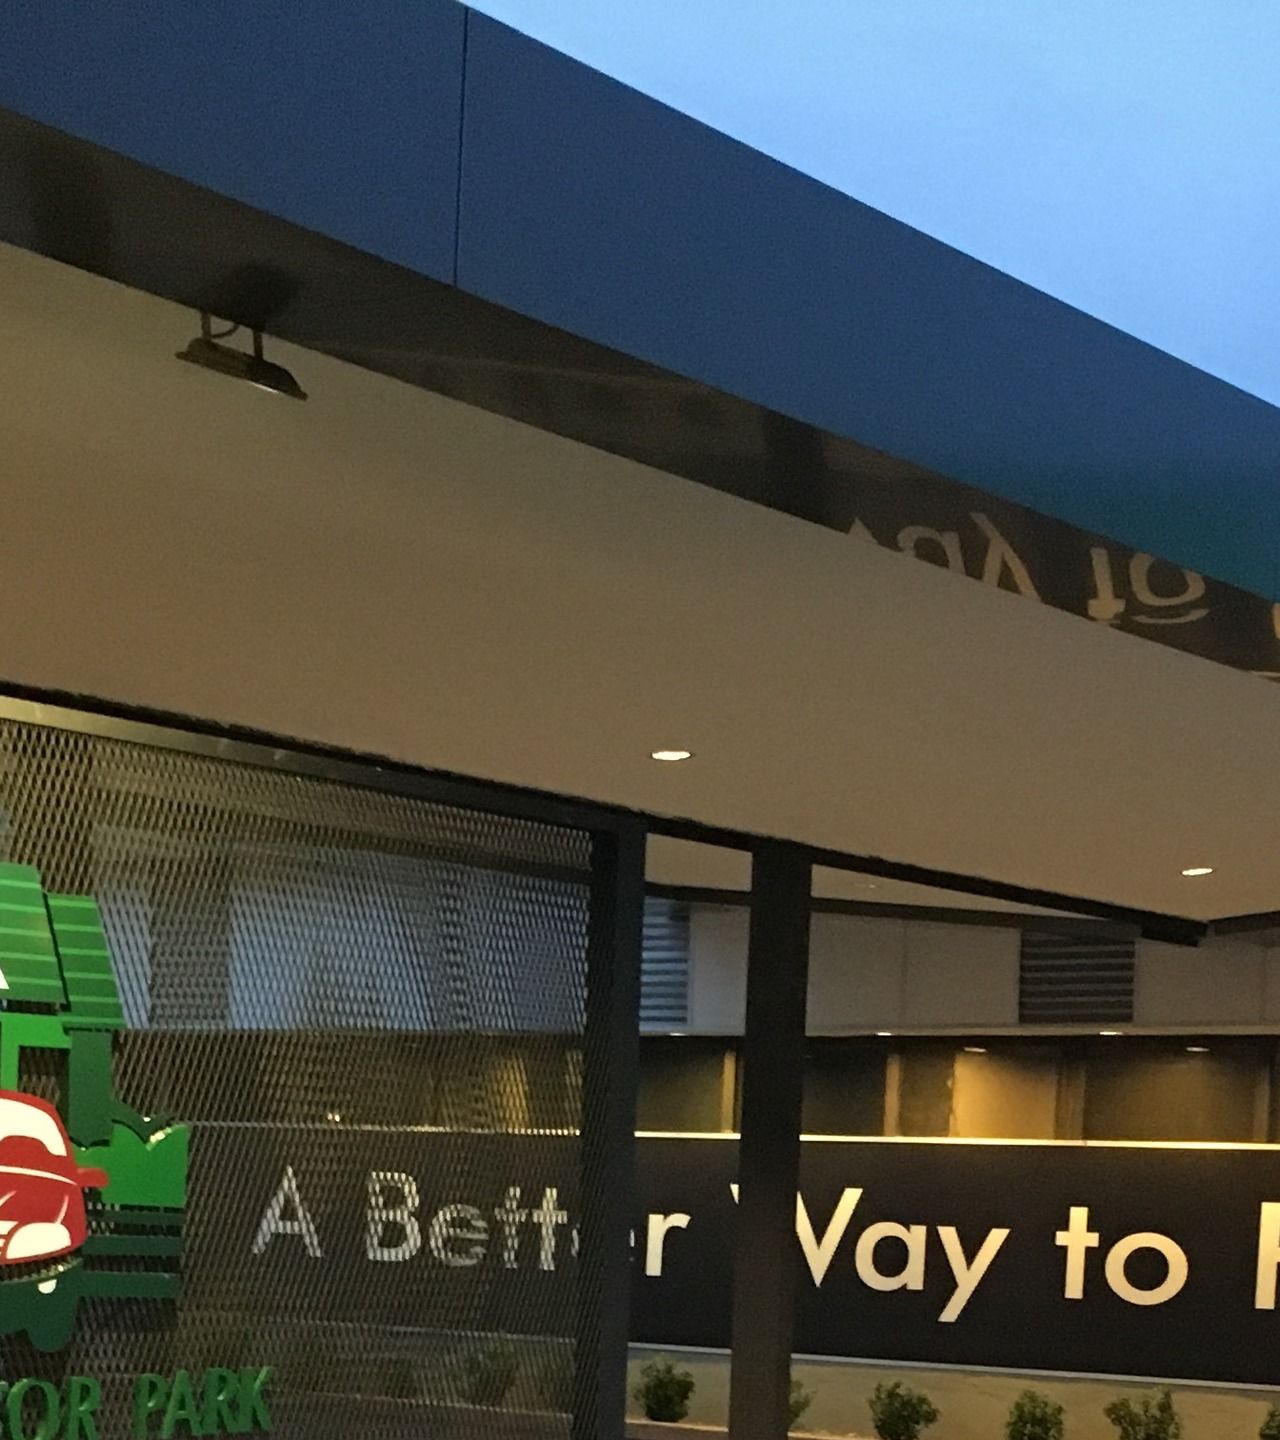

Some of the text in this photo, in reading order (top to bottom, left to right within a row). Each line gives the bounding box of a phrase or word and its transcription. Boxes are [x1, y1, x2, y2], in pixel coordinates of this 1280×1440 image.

[250, 1165, 323, 1258] A
[365, 1170, 692, 1277] Bettr
[1055, 1206, 1189, 1306] to
[132, 1365, 274, 1440] PARK
